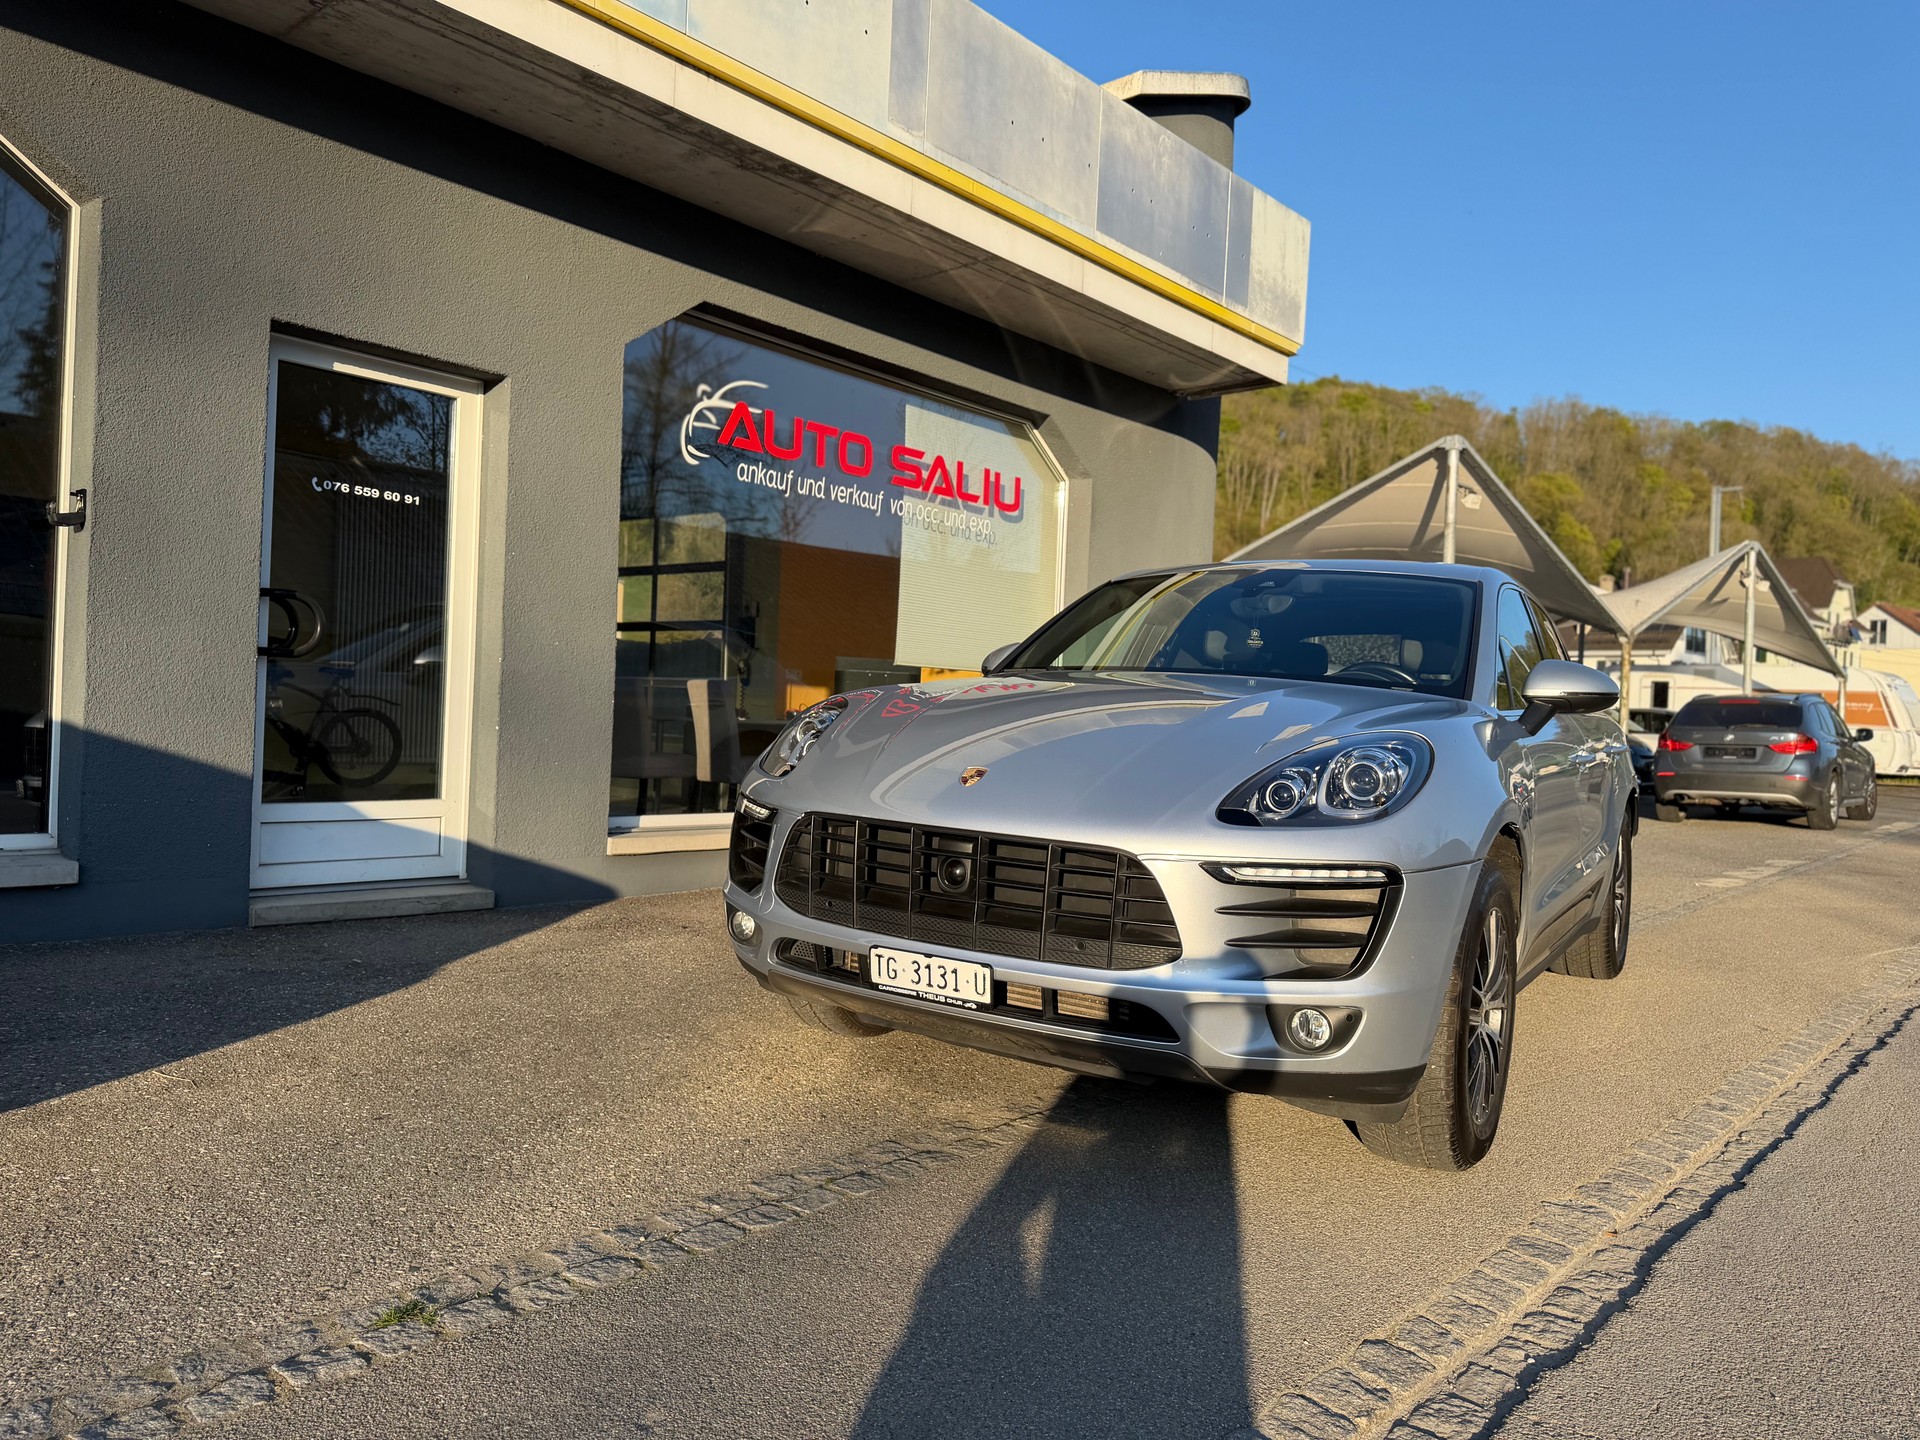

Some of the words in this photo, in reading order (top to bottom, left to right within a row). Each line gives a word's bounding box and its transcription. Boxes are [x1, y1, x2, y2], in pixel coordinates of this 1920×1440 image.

[717, 400, 874, 478] AUTO
[890, 444, 1022, 513] SALIU
[323, 480, 350, 493] 076
[354, 485, 380, 498] 559
[383, 491, 401, 502] 60
[404, 494, 420, 506] 91
[736, 461, 794, 498] ankauf
[797, 476, 826, 499] und
[829, 484, 885, 517] verkauf
[890, 498, 913, 519] von
[916, 504, 940, 524] occ.
[944, 509, 967, 530] und
[969, 516, 993, 538] exp.
[874, 953, 898, 980] TG
[910, 960, 961, 993] 3131
[974, 970, 987, 996] U
[918, 991, 946, 1003] THEUS
